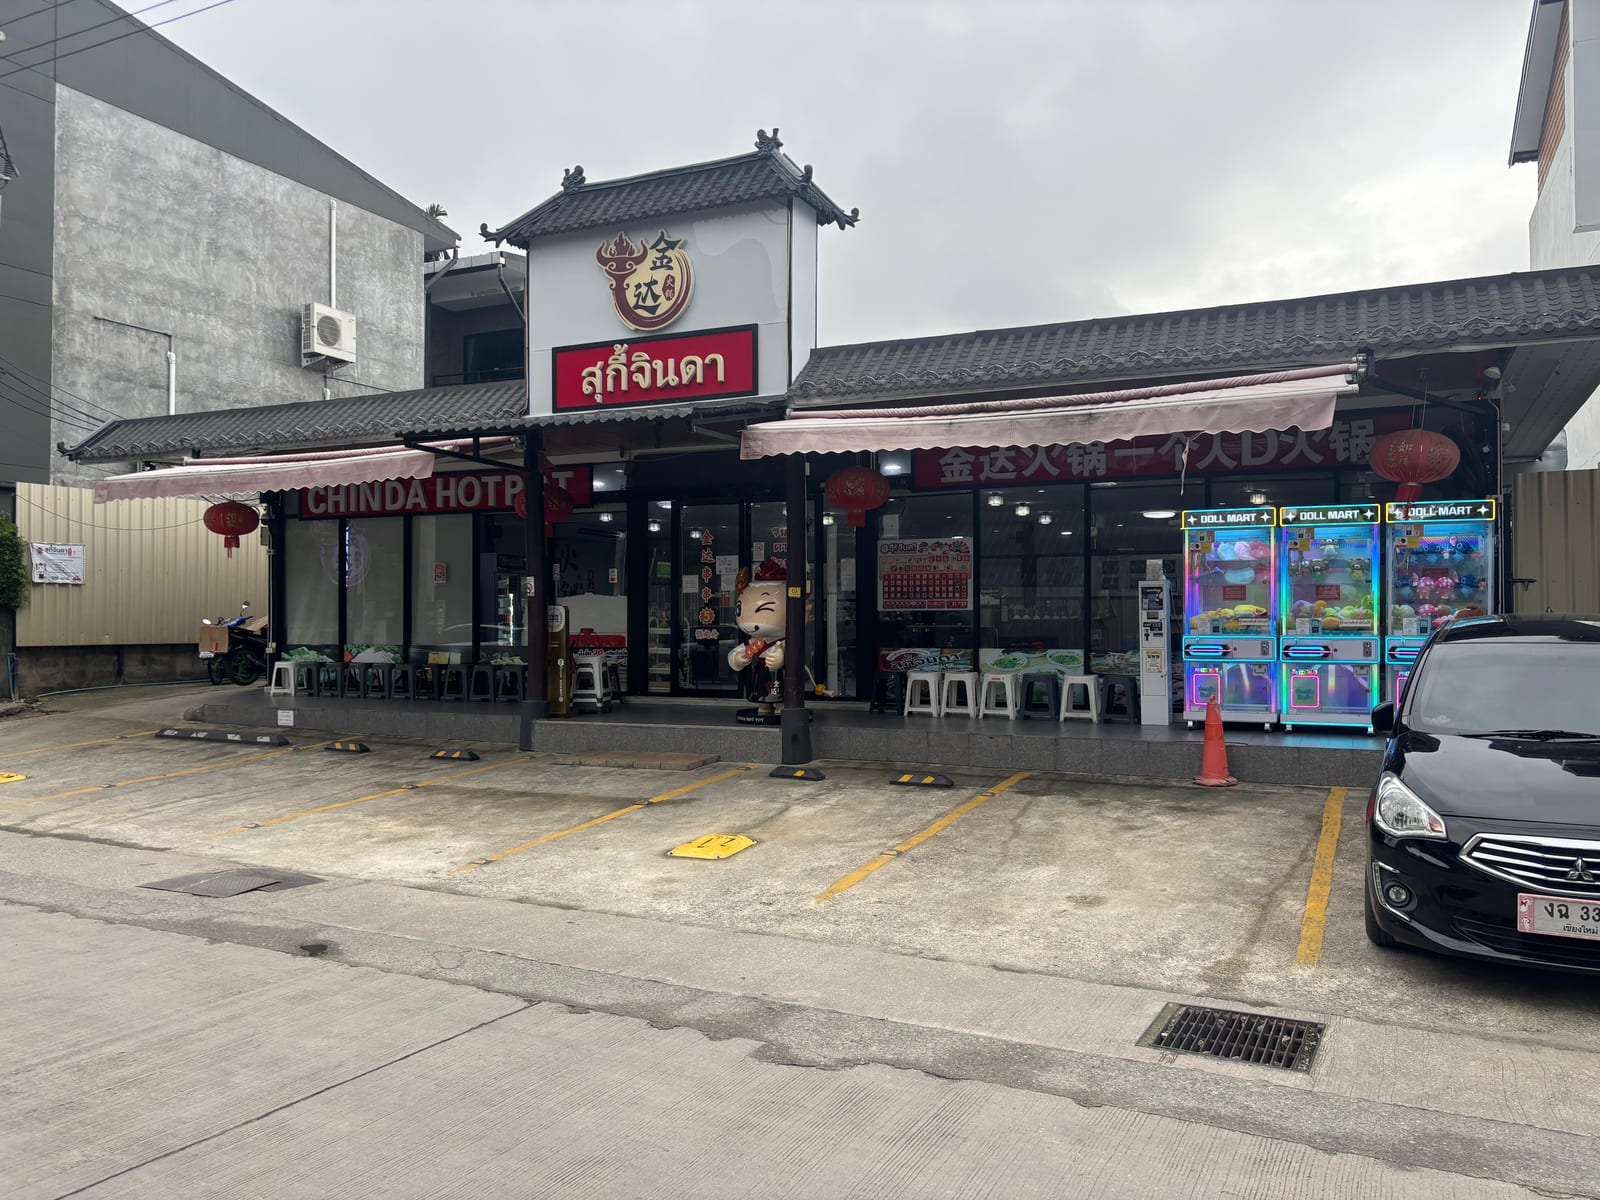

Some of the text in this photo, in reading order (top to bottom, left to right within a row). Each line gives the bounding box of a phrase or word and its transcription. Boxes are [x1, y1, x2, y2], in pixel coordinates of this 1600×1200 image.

[581, 343, 726, 404] สุกี้จินดา
[307, 471, 574, 514] CHINDA HOTPT
[1200, 513, 1257, 524] DOLL MART
[1300, 510, 1360, 521] DOLL MART
[1408, 505, 1473, 518] DOLL MART
[1544, 902, 1570, 920] งฉ
